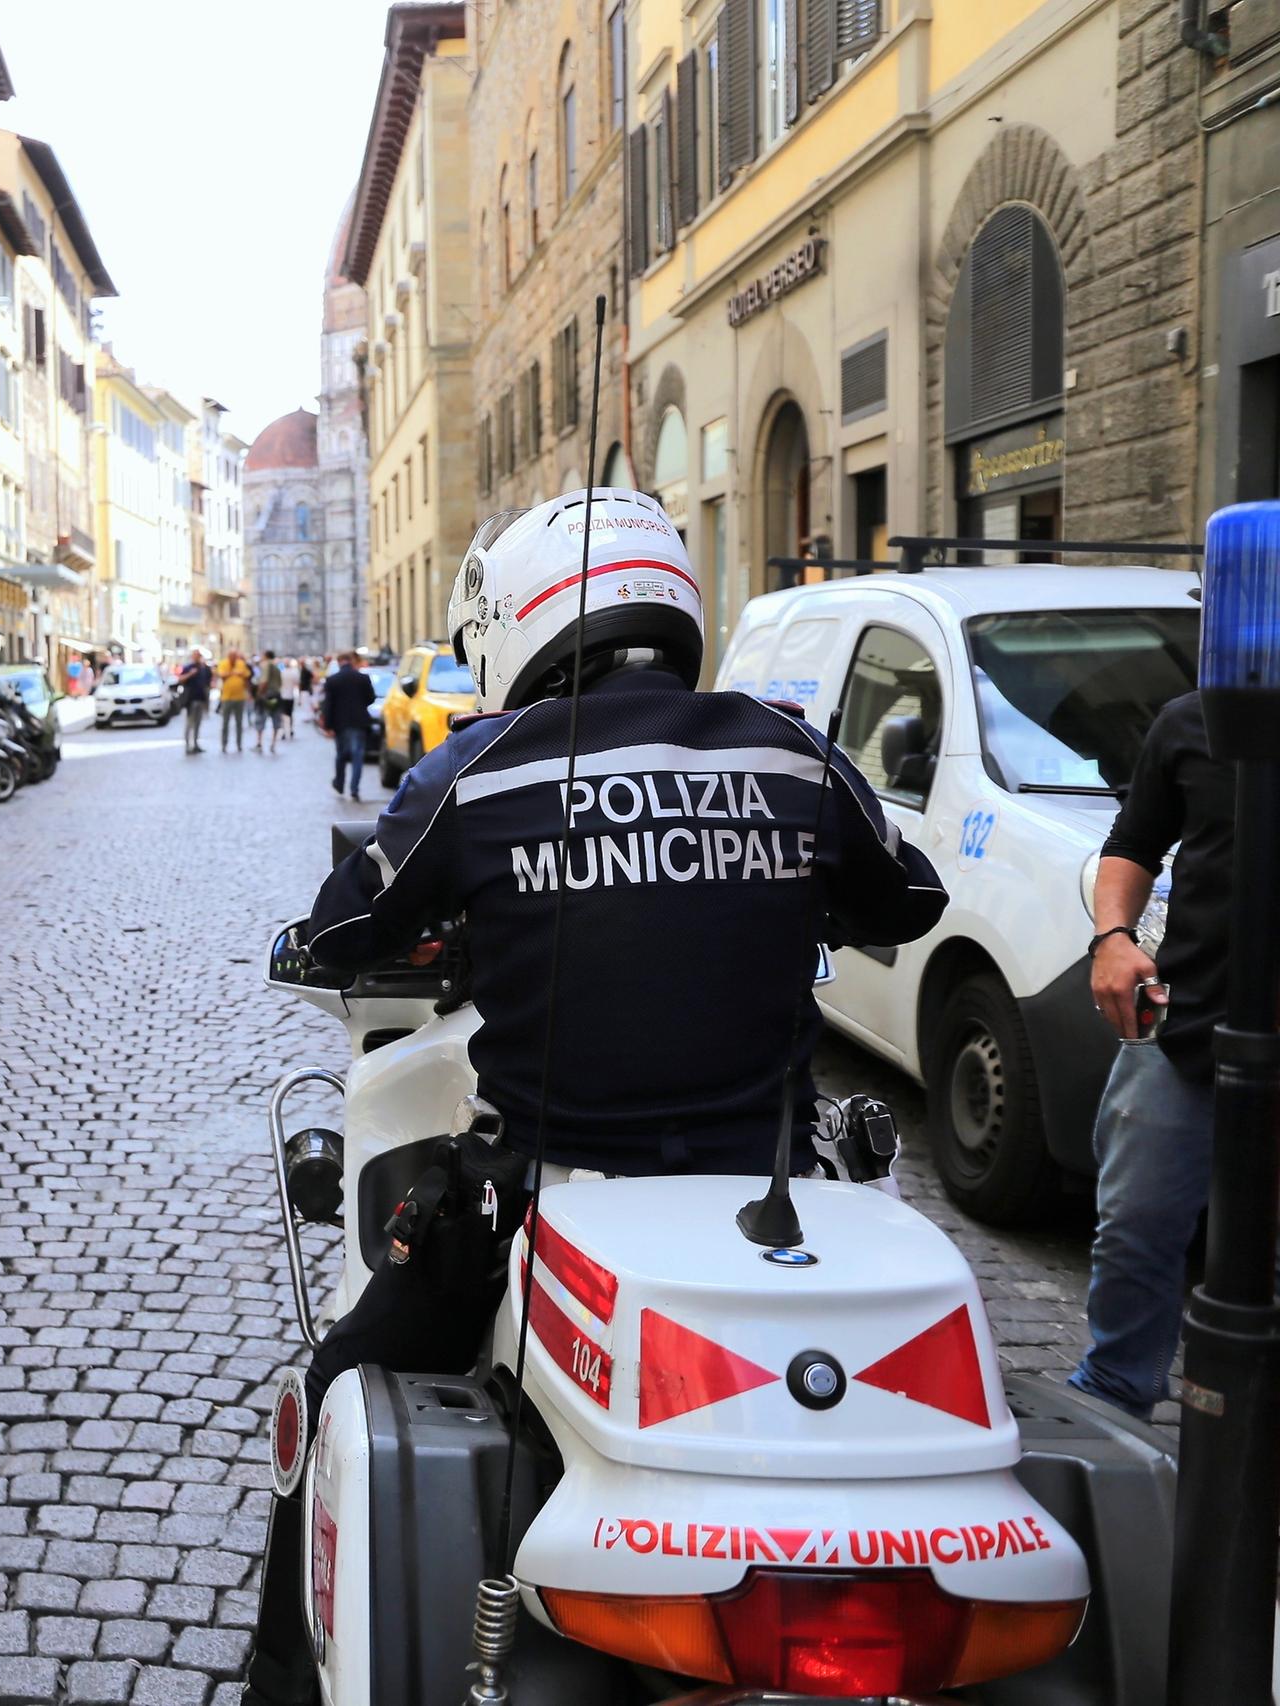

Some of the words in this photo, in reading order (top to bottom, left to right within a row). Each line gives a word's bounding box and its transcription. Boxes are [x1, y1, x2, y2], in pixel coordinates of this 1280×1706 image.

[764, 239, 816, 302] PERSEO
[560, 773, 775, 829] POLIZIA
[511, 827, 816, 893] MUNICIPALE
[959, 811, 995, 859] 132
[572, 1336, 602, 1393] 104
[593, 1517, 795, 1563] POLIZIA
[800, 1515, 1052, 1566] MUNICIPALE
